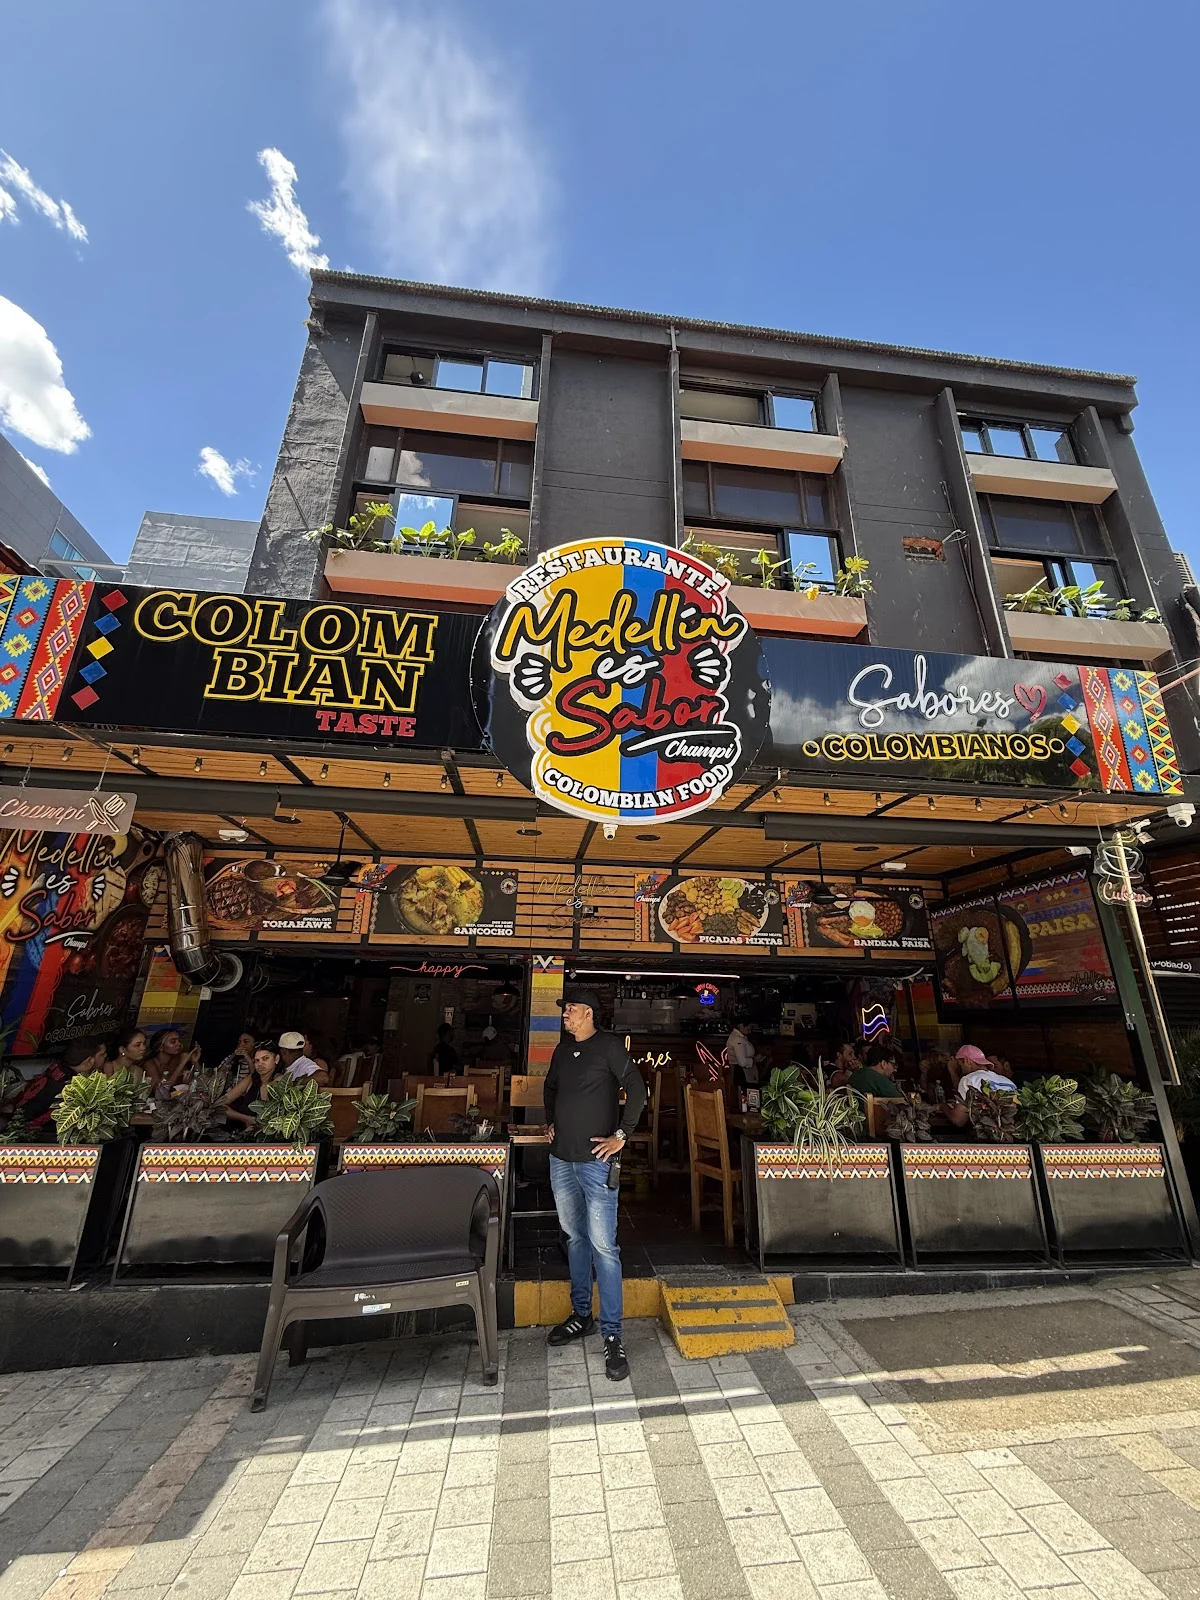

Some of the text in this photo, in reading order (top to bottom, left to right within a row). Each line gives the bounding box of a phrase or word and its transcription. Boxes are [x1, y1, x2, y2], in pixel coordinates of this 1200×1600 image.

[511, 547, 721, 601] RESTAURANTE
[134, 590, 440, 662] COLOM
[501, 592, 739, 668] Medellín
[203, 647, 425, 713] BIAN
[597, 653, 658, 684] es
[847, 653, 1015, 729] Sabores
[315, 709, 417, 737] TASTE
[550, 678, 720, 751] Sabor
[665, 738, 735, 763] Champi
[821, 733, 1051, 761] COLOMBIANOS
[543, 764, 729, 809] COLOMBIAN FOOD
[0, 798, 88, 826] Champi
[46, 874, 77, 894] es
[6, 889, 95, 941] Sabor
[566, 898, 587, 909] es
[262, 920, 332, 929] TOMAHAWK
[453, 926, 514, 936] SANCOCHO
[1027, 913, 1096, 940] PAISA
[64, 937, 89, 951] Champi
[698, 935, 783, 946] PICADAS MIXTAS
[853, 939, 931, 949] BANDEJA PAISA
[404, 961, 478, 978] happy
[66, 988, 115, 1028] Sabores
